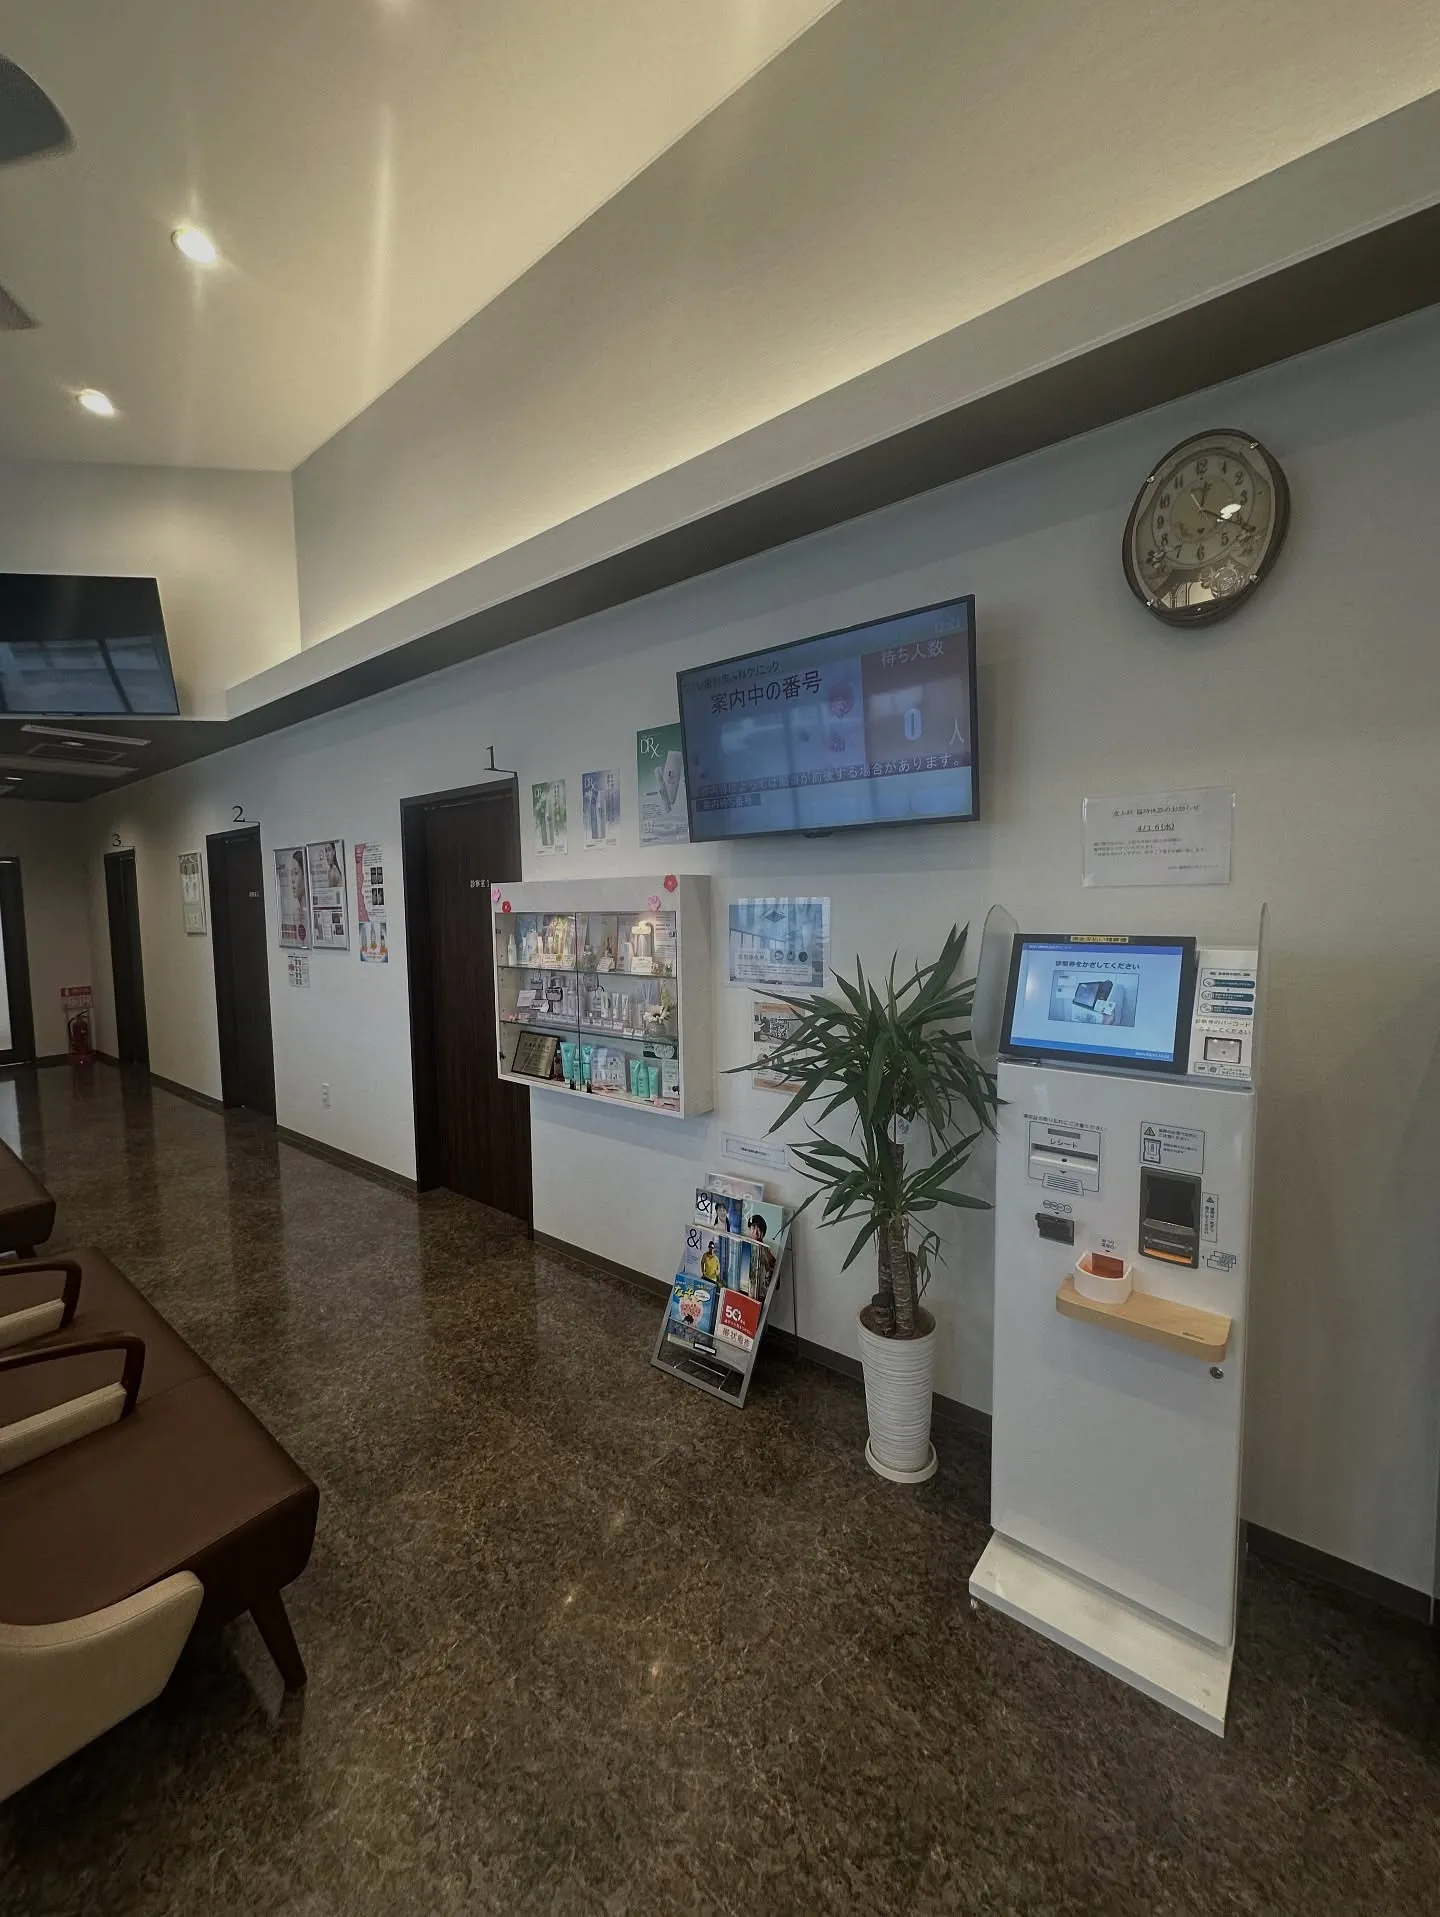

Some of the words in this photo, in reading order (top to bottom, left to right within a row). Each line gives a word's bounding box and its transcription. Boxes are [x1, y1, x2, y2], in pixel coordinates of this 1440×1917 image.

[1196, 458, 1209, 475] 12
[1222, 460, 1228, 475] 1
[1173, 474, 1184, 489] 11
[1235, 471, 1243, 486] 2
[1158, 494, 1171, 510] 10
[1157, 516, 1165, 530] 9
[1161, 532, 1169, 547] 8
[1221, 532, 1229, 546] 5
[1175, 545, 1182, 559] 7
[1197, 545, 1205, 561] 6
[881, 639, 945, 669] 待ち人数
[710, 670, 823, 715] 案内中の番号
[904, 707, 923, 741] 0
[949, 717, 965, 745] 人
[483, 744, 497, 771] 1
[232, 805, 246, 823] 2
[111, 833, 122, 847] 3
[1055, 959, 1140, 971] 診察券をかざしてください
[1049, 1137, 1078, 1149] レシート
[696, 1191, 711, 1213] &
[686, 1228, 700, 1251] &
[724, 1303, 742, 1320] 50
